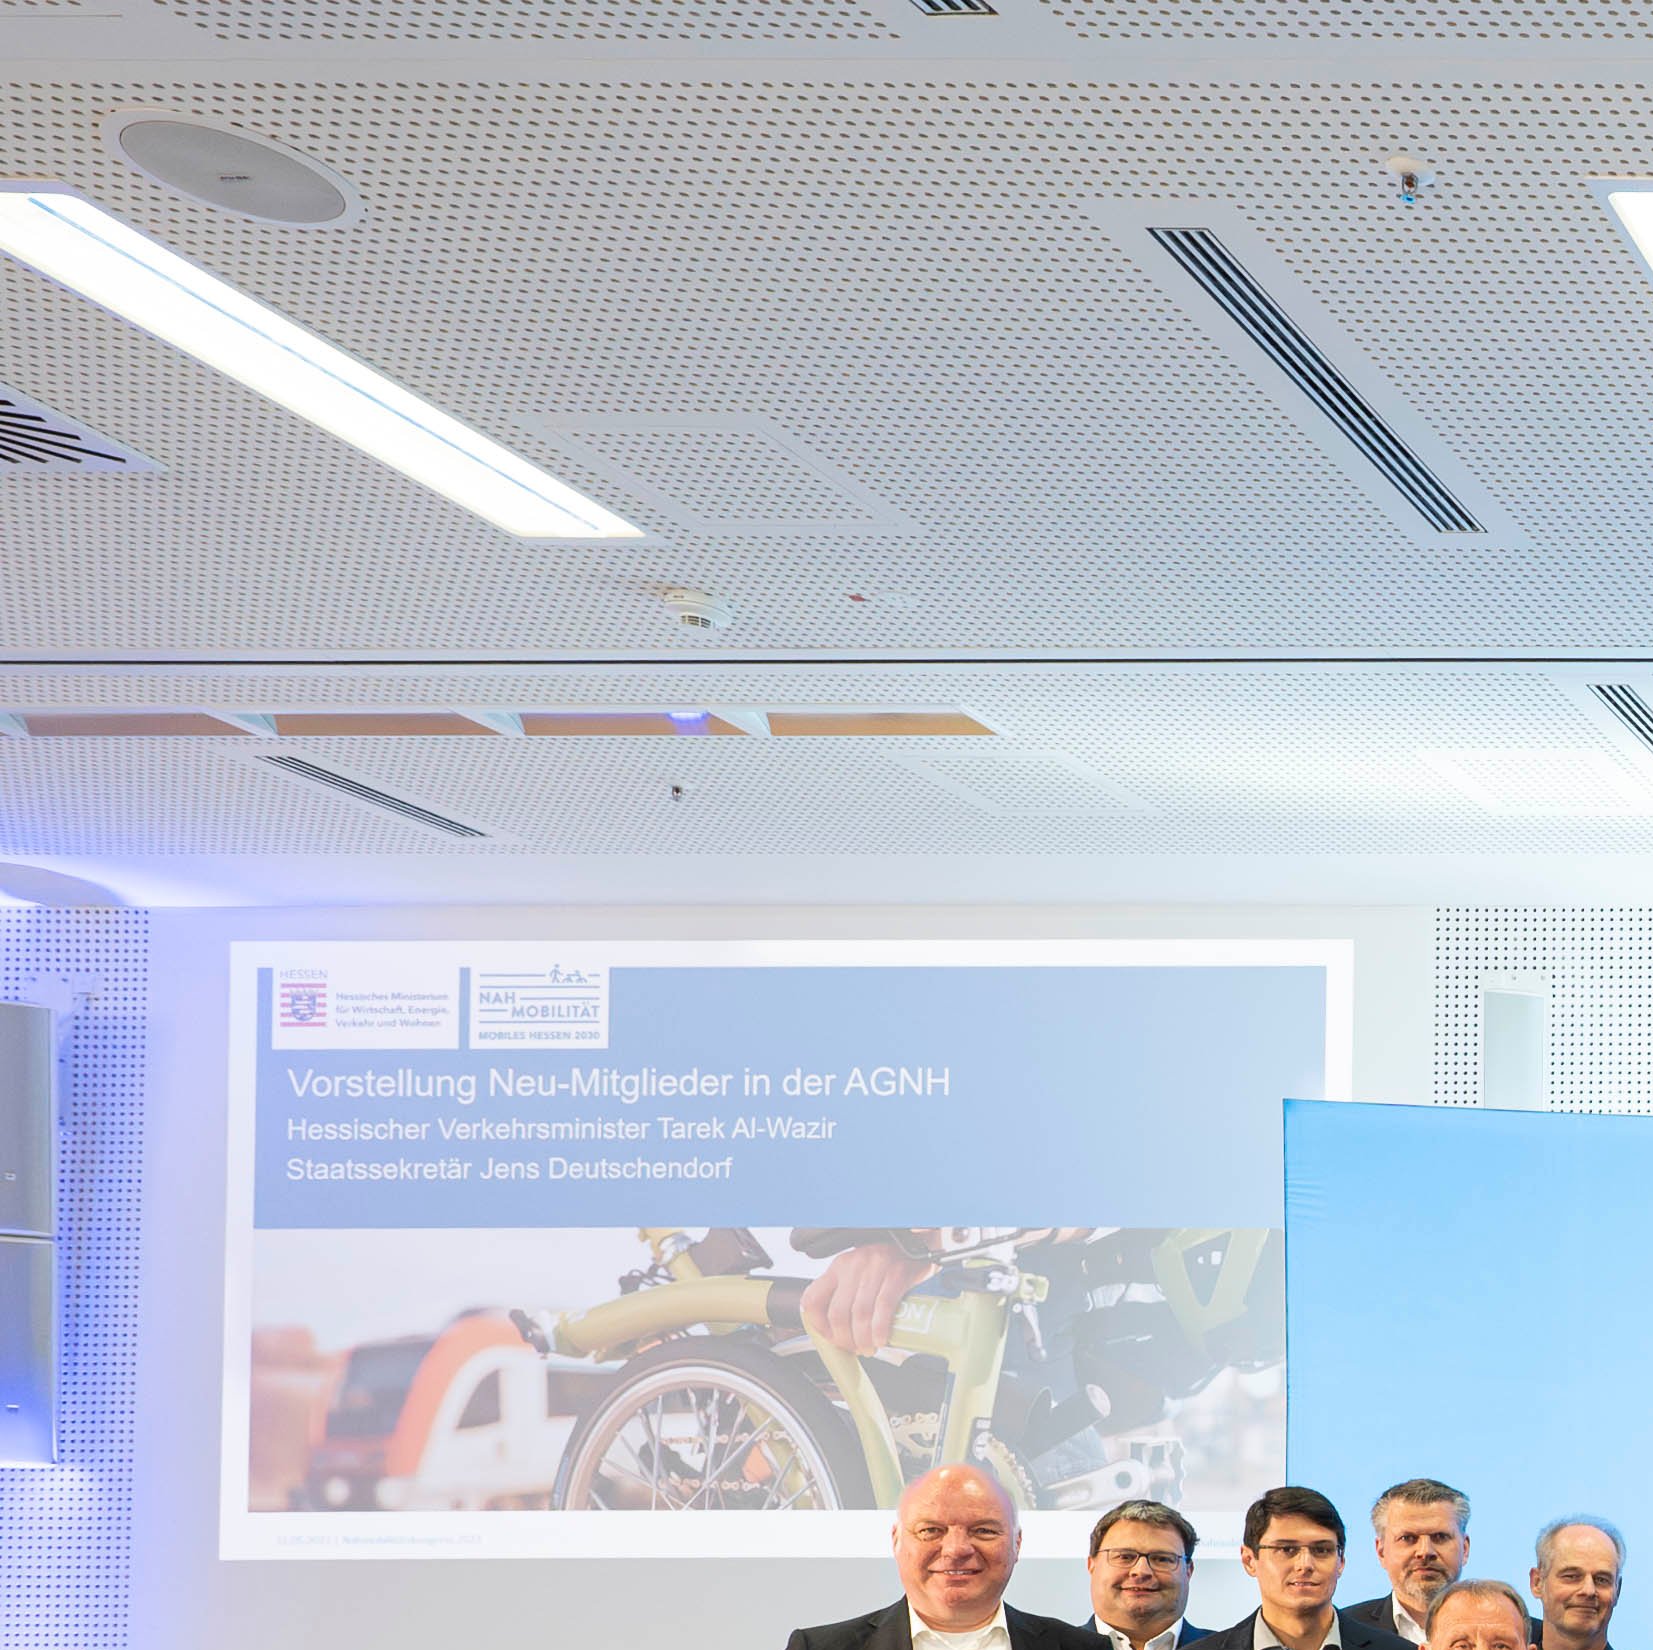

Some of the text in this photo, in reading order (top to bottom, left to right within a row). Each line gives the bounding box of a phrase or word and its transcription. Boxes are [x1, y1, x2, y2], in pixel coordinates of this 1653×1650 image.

[280, 969, 328, 980] HESSEN
[479, 992, 516, 1005] NAH
[511, 1001, 600, 1019] MOBILITÄT
[478, 1031, 600, 1041] MOBILES HESSEN 2030
[288, 1066, 950, 1104] Vorstellung Neu-Mitglieder in der AGNH
[287, 1116, 837, 1141] Hessischer Verkehrsminister Tarek Al-Wazir
[286, 1156, 734, 1180] Staatssekretär Jens Deutschendorf
